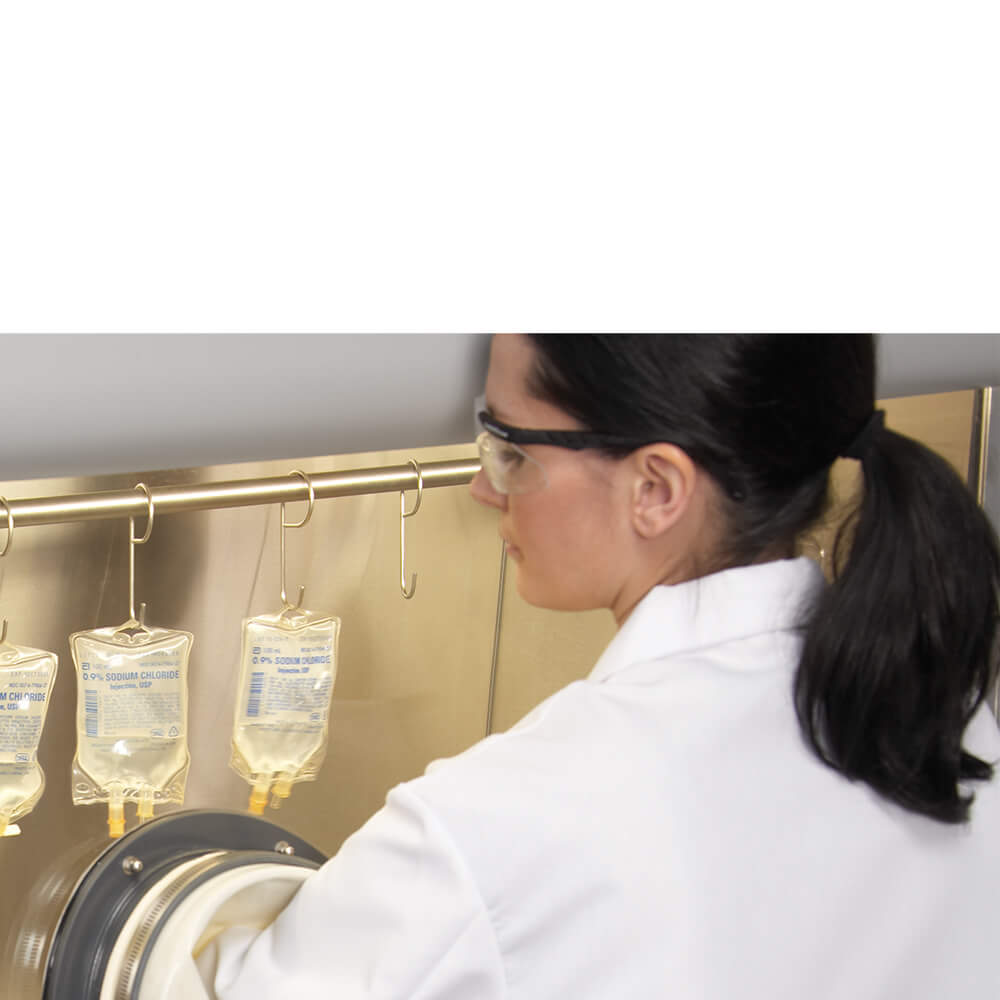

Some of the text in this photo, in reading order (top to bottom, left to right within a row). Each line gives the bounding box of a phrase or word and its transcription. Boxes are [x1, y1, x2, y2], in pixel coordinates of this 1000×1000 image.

[274, 656, 300, 665] SODIUM
[105, 671, 139, 682] SODIUM
[140, 670, 180, 680] CHLORIDE
[8, 692, 46, 702] CHLORIDE
